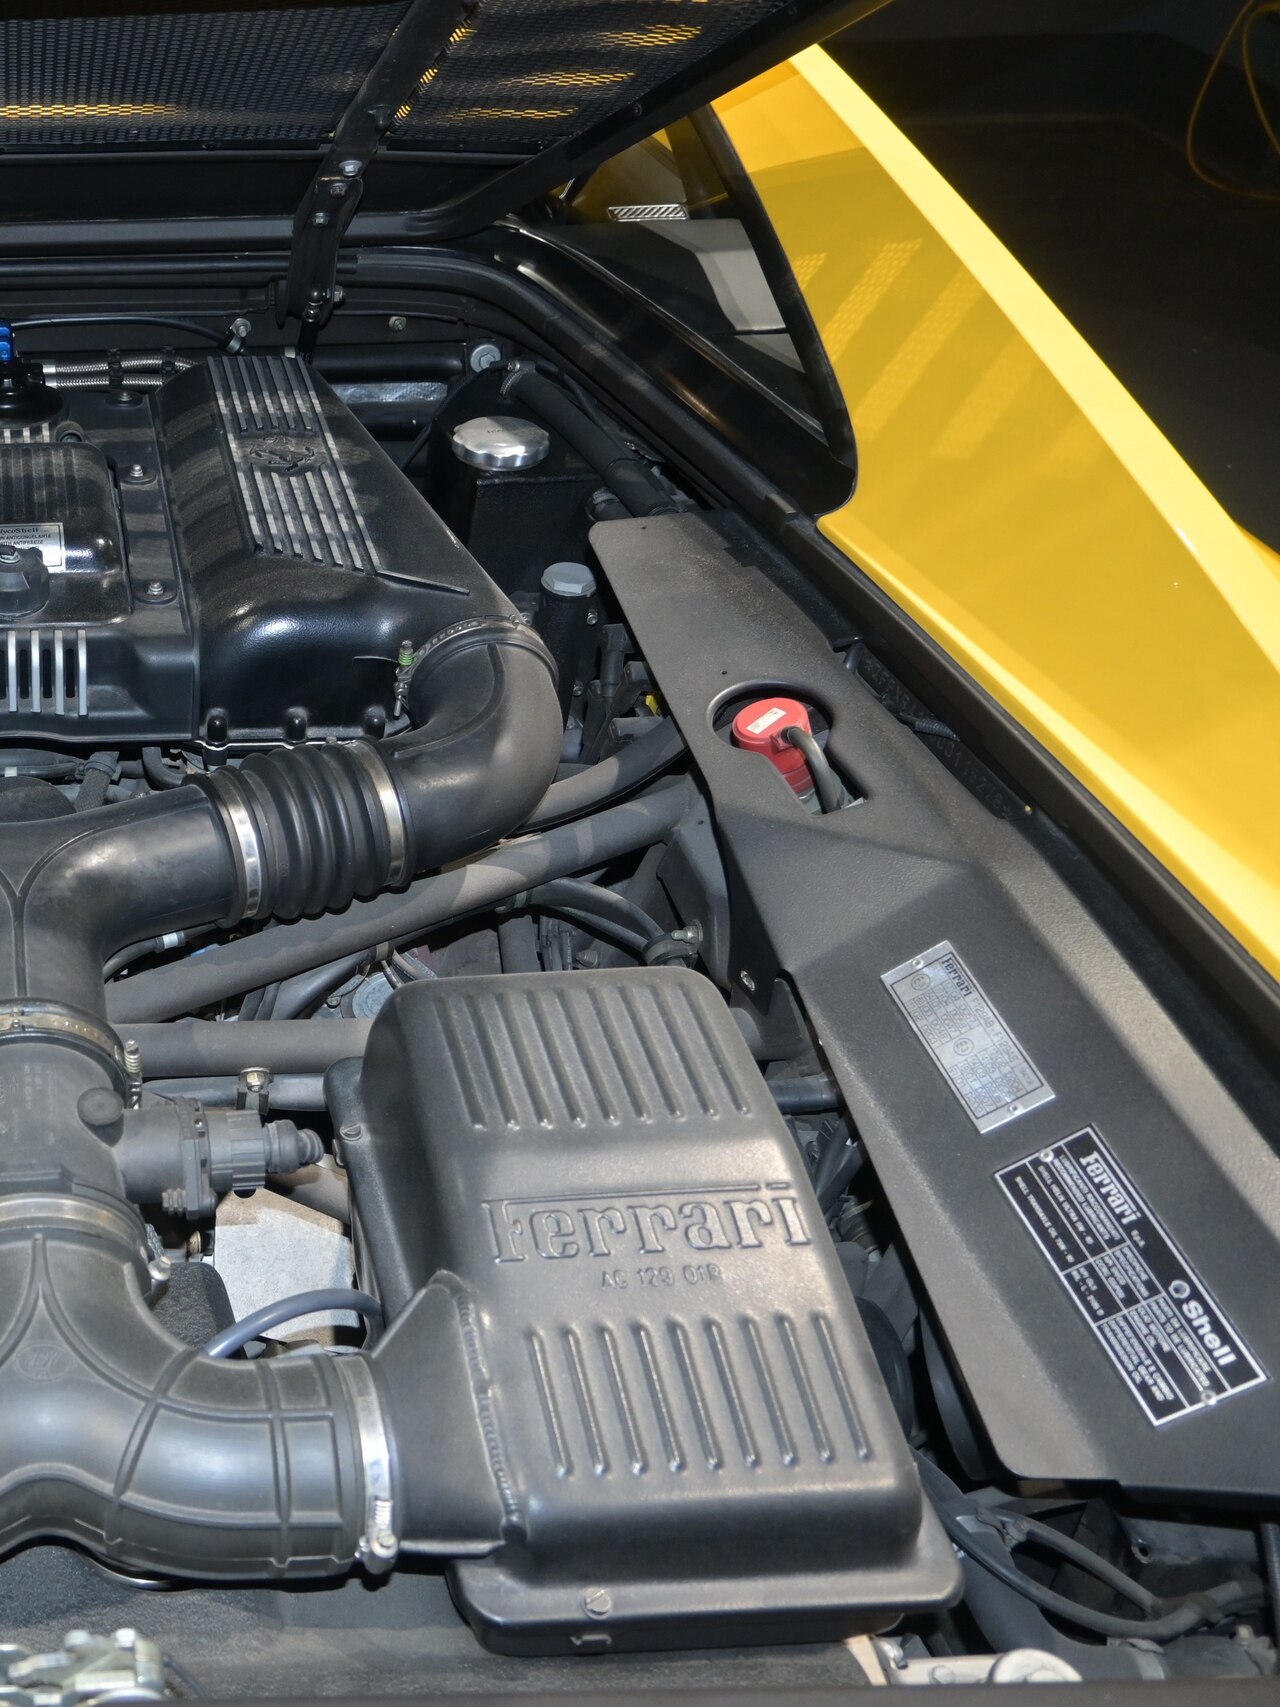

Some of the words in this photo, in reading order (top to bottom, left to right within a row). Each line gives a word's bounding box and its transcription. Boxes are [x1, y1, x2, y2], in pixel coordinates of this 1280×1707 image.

[940, 956, 975, 997] Ferrari
[1013, 1175, 1031, 1196] SHELL
[1036, 1164, 1054, 1185] SHELL
[1050, 1157, 1086, 1204] RECOMMENDED
[1077, 1149, 1142, 1226] Ferrari
[482, 1182, 813, 1263] Ferrari
[601, 1271, 628, 1289] AC
[1178, 1297, 1239, 1367] Shell
